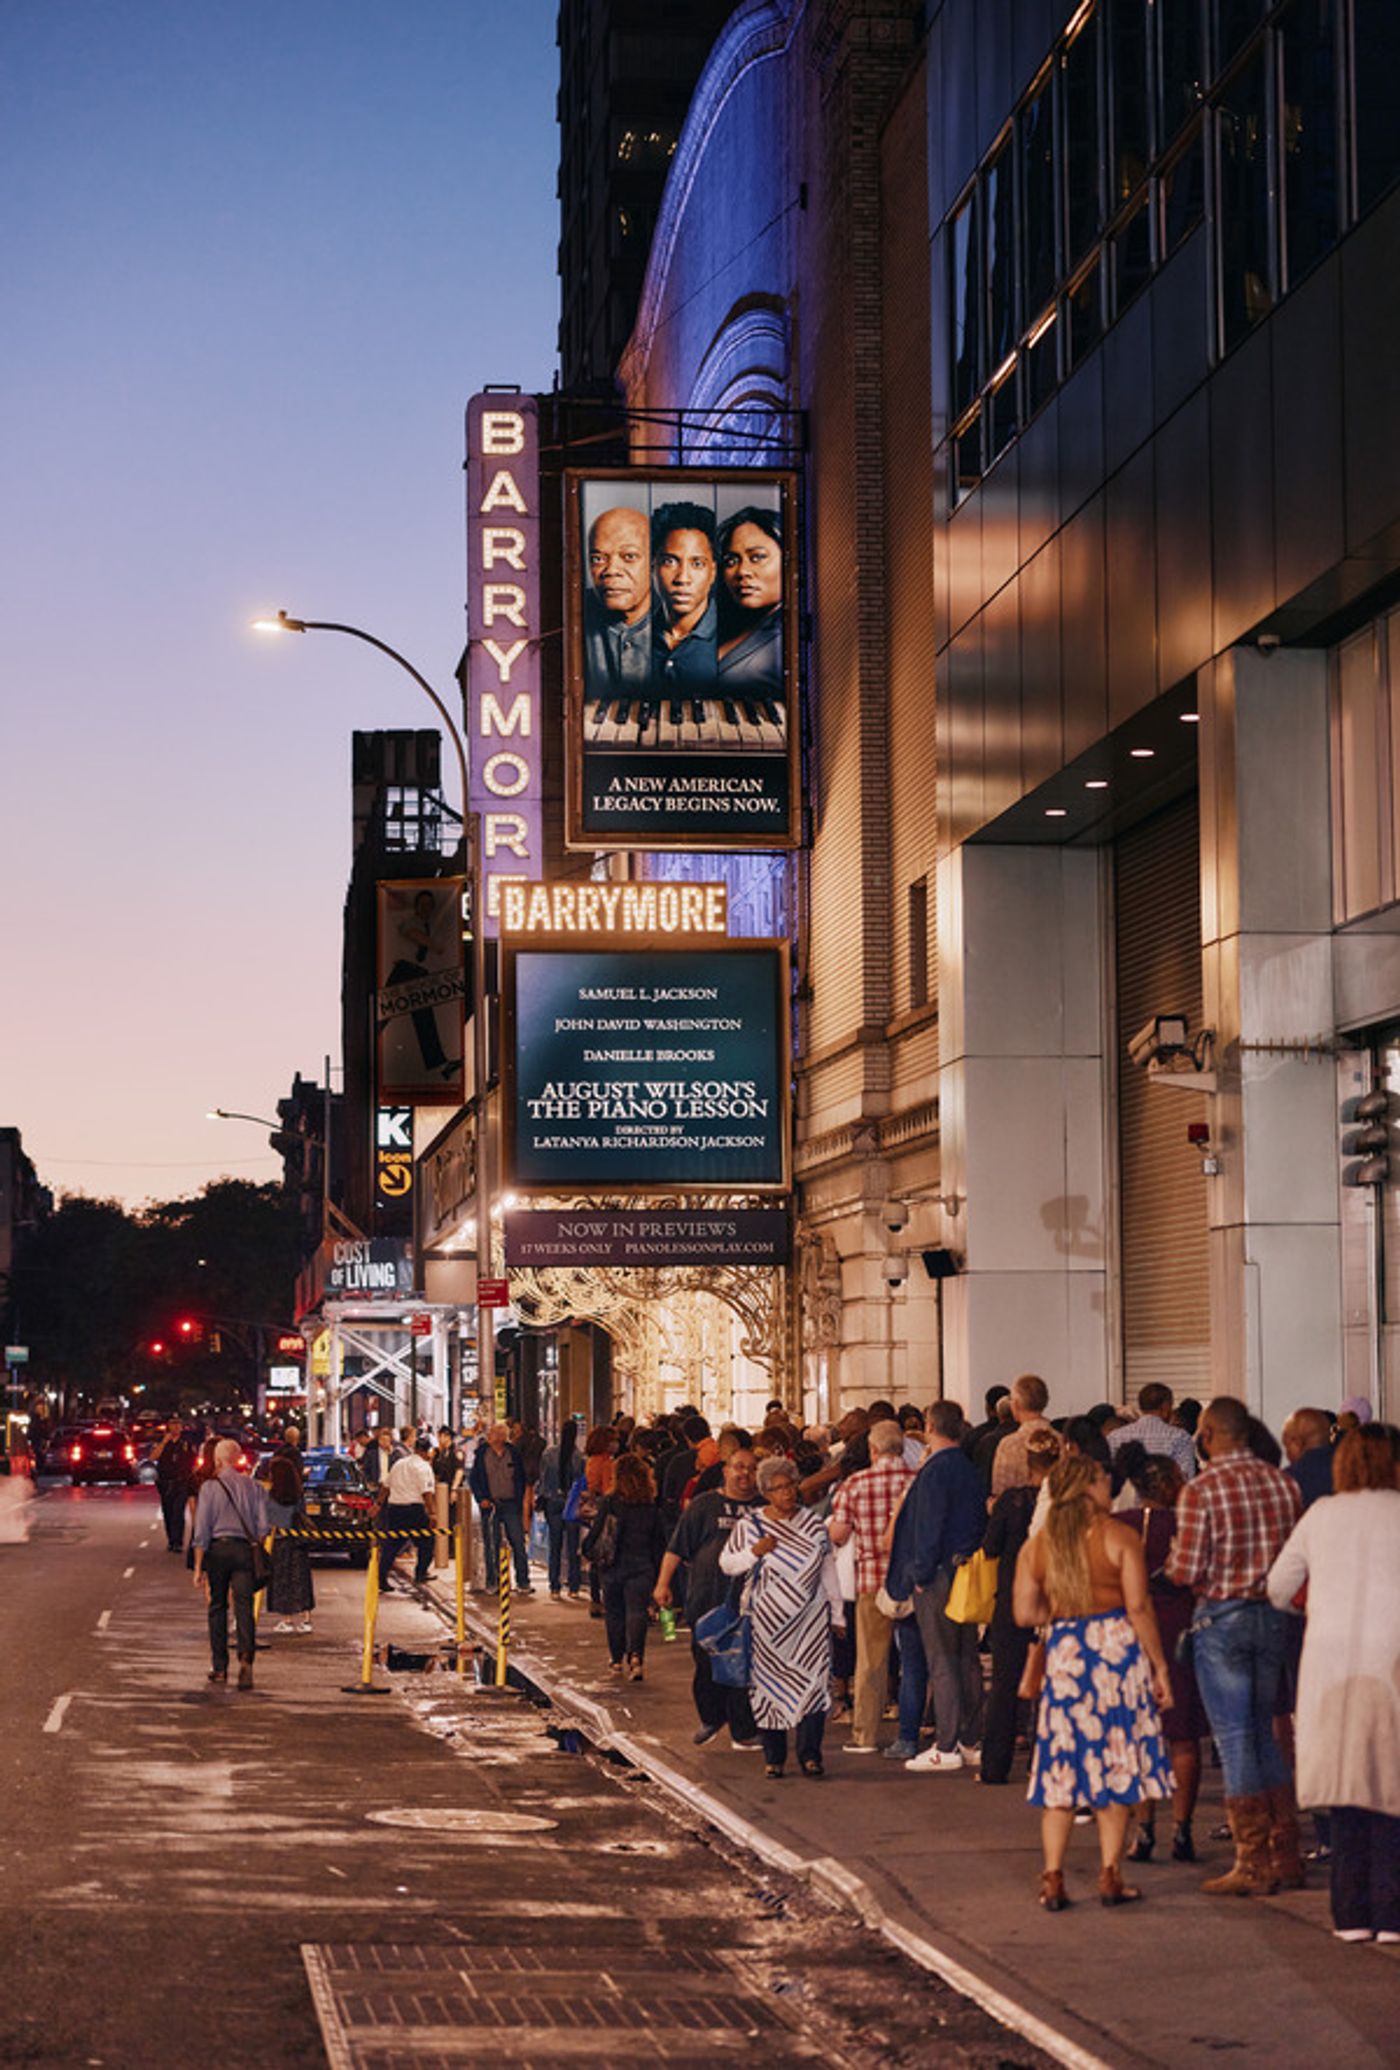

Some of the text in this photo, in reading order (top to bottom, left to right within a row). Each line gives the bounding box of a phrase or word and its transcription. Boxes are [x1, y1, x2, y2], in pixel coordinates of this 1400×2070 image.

[608, 777, 764, 793] A NEW AMERICAN
[593, 796, 781, 813] LEGACY BEGINS NOW.
[504, 885, 727, 933] BARRYMORE
[578, 988, 718, 1003] SAMUEL L. JACKSON
[554, 1018, 742, 1033] JOHN DAVID WASHINGTON
[583, 1049, 716, 1062] DANIELLE BROOKS
[540, 1080, 756, 1100] AUGUST WILSON'S
[526, 1100, 769, 1119] THE PIANO LESSON
[377, 1107, 413, 1146] K
[615, 1125, 685, 1135] DIRECTED BY
[533, 1136, 766, 1150] LATANYA RICHARDSON JACKSON
[557, 1221, 737, 1238] NOW IN PREVIEWS
[333, 1241, 372, 1266] COST
[534, 1242, 577, 1254] WEEKS
[578, 1242, 613, 1254] ONLY
[625, 1242, 775, 1254] PIANOLESSONPLAY.COM
[331, 1262, 396, 1289] OF LIVING
